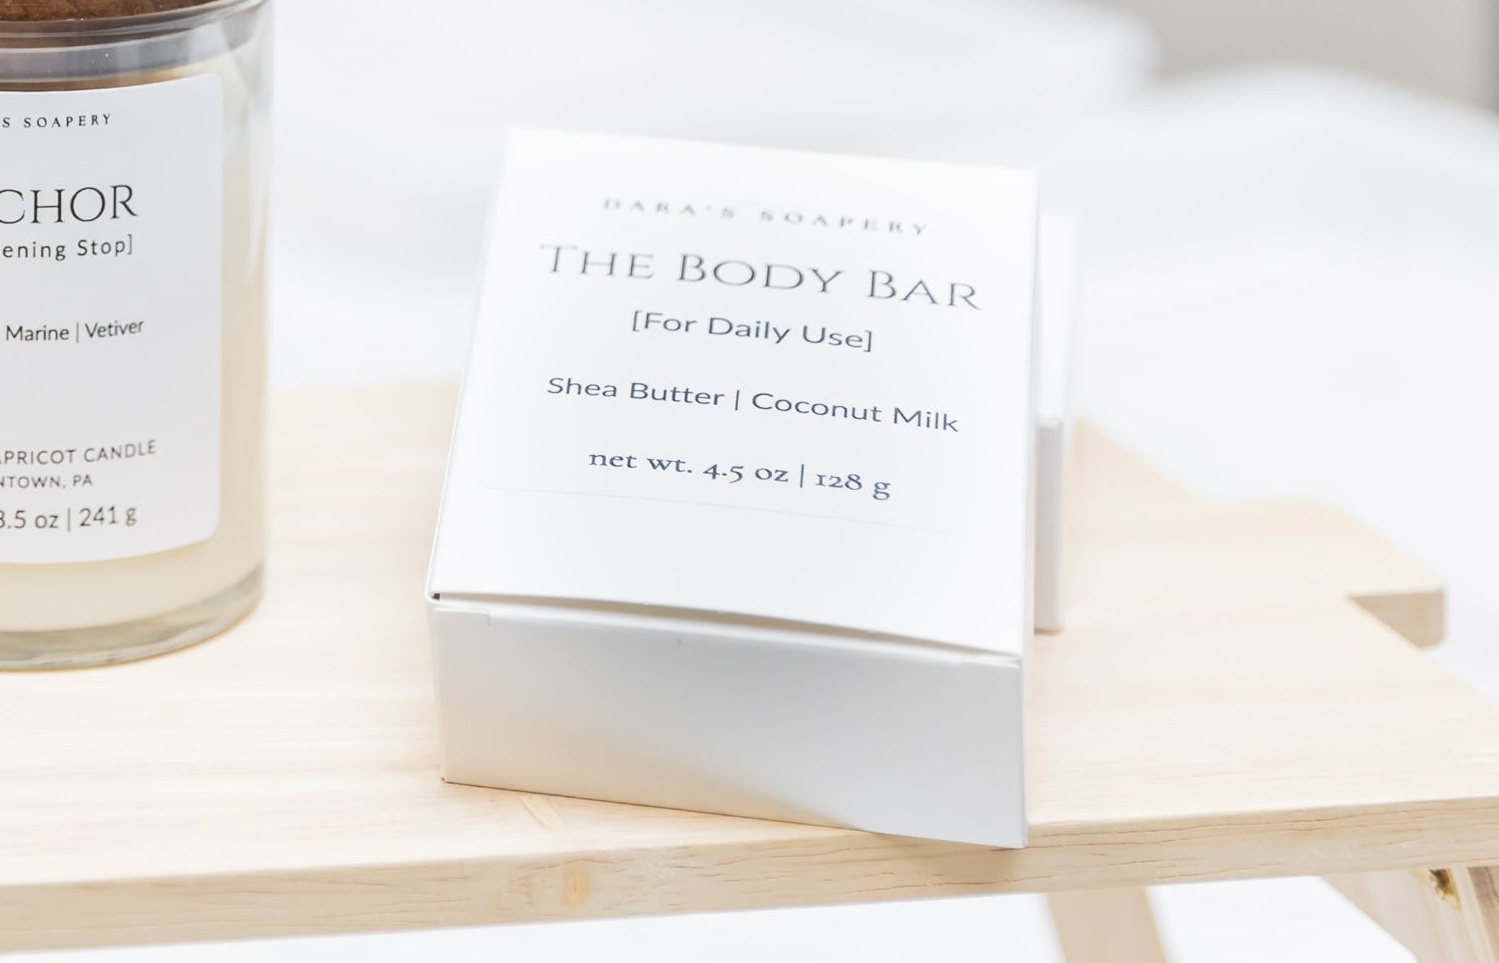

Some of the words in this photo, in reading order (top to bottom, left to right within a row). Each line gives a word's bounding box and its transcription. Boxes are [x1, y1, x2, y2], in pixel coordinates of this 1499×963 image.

[23, 113, 111, 129] SOAPERY
[603, 198, 736, 220] DARA'S
[760, 210, 926, 236] SOAPERY
[76, 233, 133, 257] Stop]
[540, 243, 653, 279] THE
[678, 254, 845, 293] BODY
[867, 270, 980, 310] BAR
[5, 324, 70, 342] Marine
[84, 320, 145, 339] Vetiver
[632, 310, 698, 333] [For
[708, 317, 791, 345] Daily
[802, 324, 873, 353] Use]
[547, 377, 618, 398] Shea
[629, 382, 726, 406] Butter
[751, 392, 883, 423] Coconut
[893, 406, 959, 433] Milk
[83, 439, 156, 463] CANDLE
[72, 473, 93, 487] PA
[588, 453, 638, 469] net
[646, 457, 693, 474] wt.
[702, 463, 745, 484] 4.5
[754, 467, 789, 483] oz
[815, 473, 863, 491] 128
[872, 481, 892, 501] g
[34, 513, 60, 530] oz
[79, 505, 118, 528] 241
[124, 506, 138, 527] g
